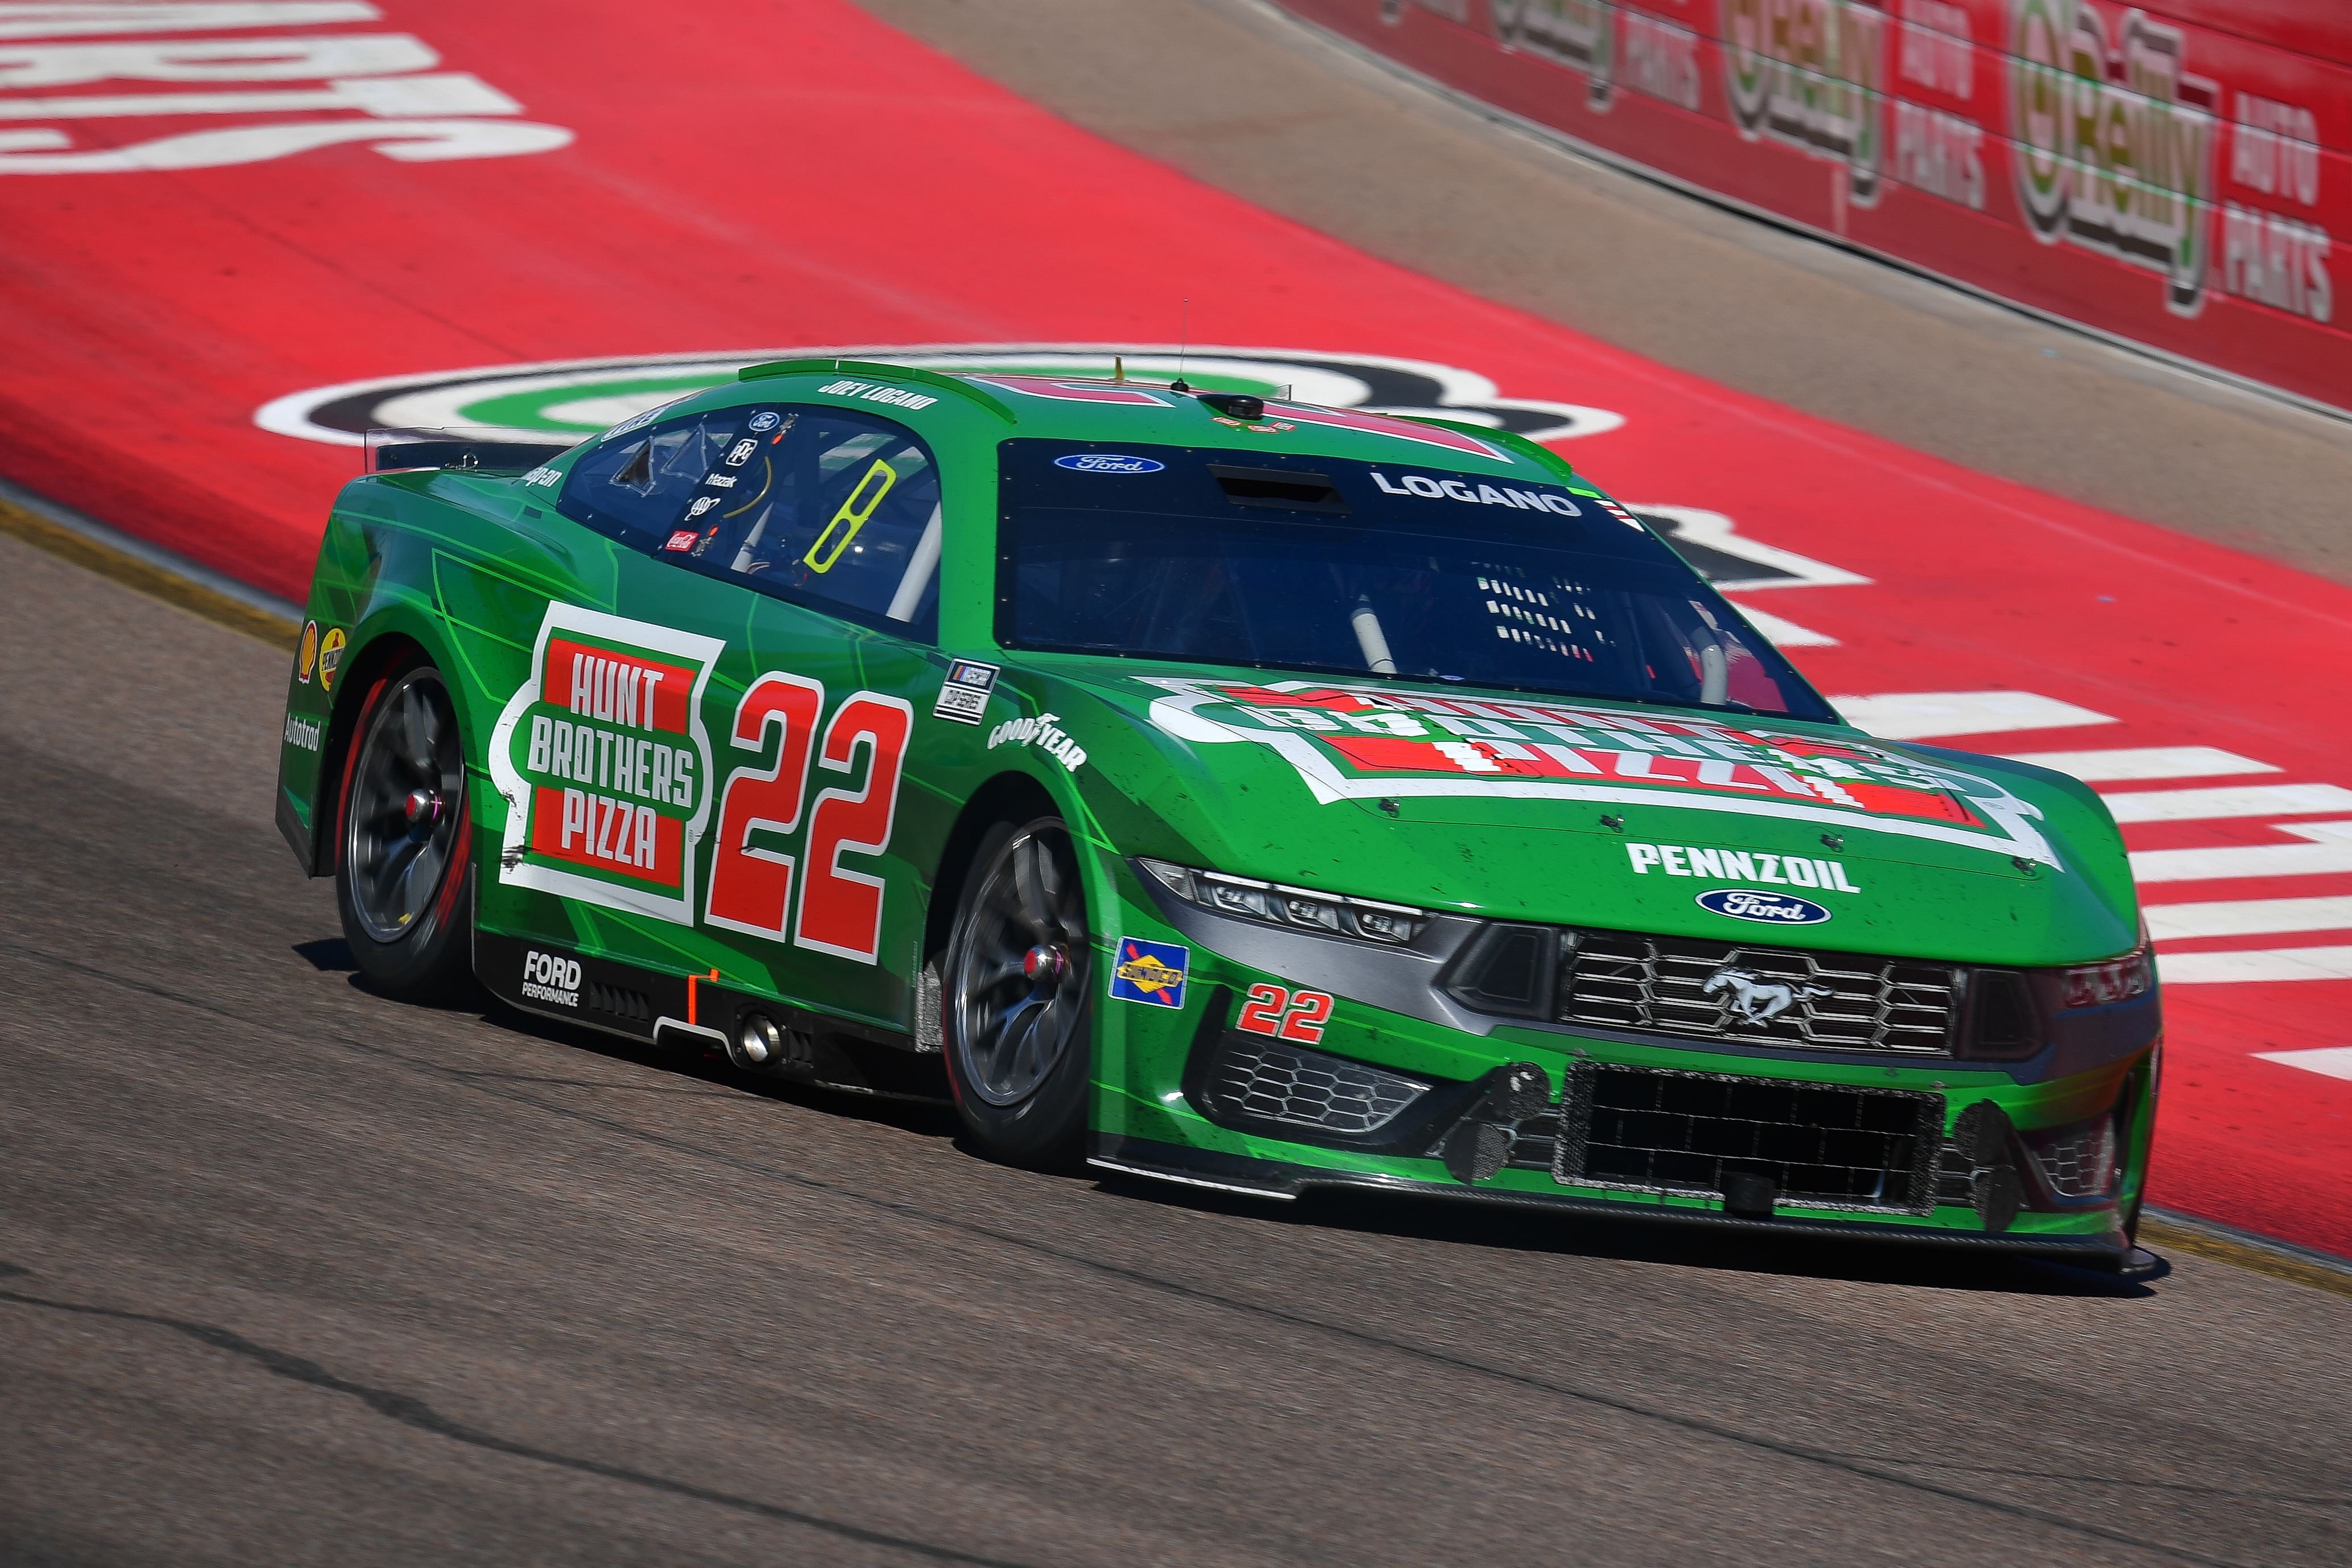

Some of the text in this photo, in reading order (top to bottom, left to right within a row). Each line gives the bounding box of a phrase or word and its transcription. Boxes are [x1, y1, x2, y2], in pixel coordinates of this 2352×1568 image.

[2231, 90, 2319, 206] AUTO
[2223, 200, 2333, 322] PARTS
[818, 380, 875, 397] JOEY
[859, 386, 938, 410] LOGANO
[705, 473, 737, 488] Mazak
[1076, 456, 1143, 471] Ford
[1369, 466, 1582, 517] LOGANO
[570, 652, 664, 732] HUNT
[527, 715, 694, 808] BROTHERS
[561, 788, 657, 870] PIZZA
[704, 671, 914, 966] 22
[1625, 843, 1862, 894] PENNZOIL
[1722, 892, 1807, 921] Ford
[522, 982, 579, 1007] PERFORMANCE
[524, 951, 581, 990] FORD
[1235, 983, 1335, 1045] 22
